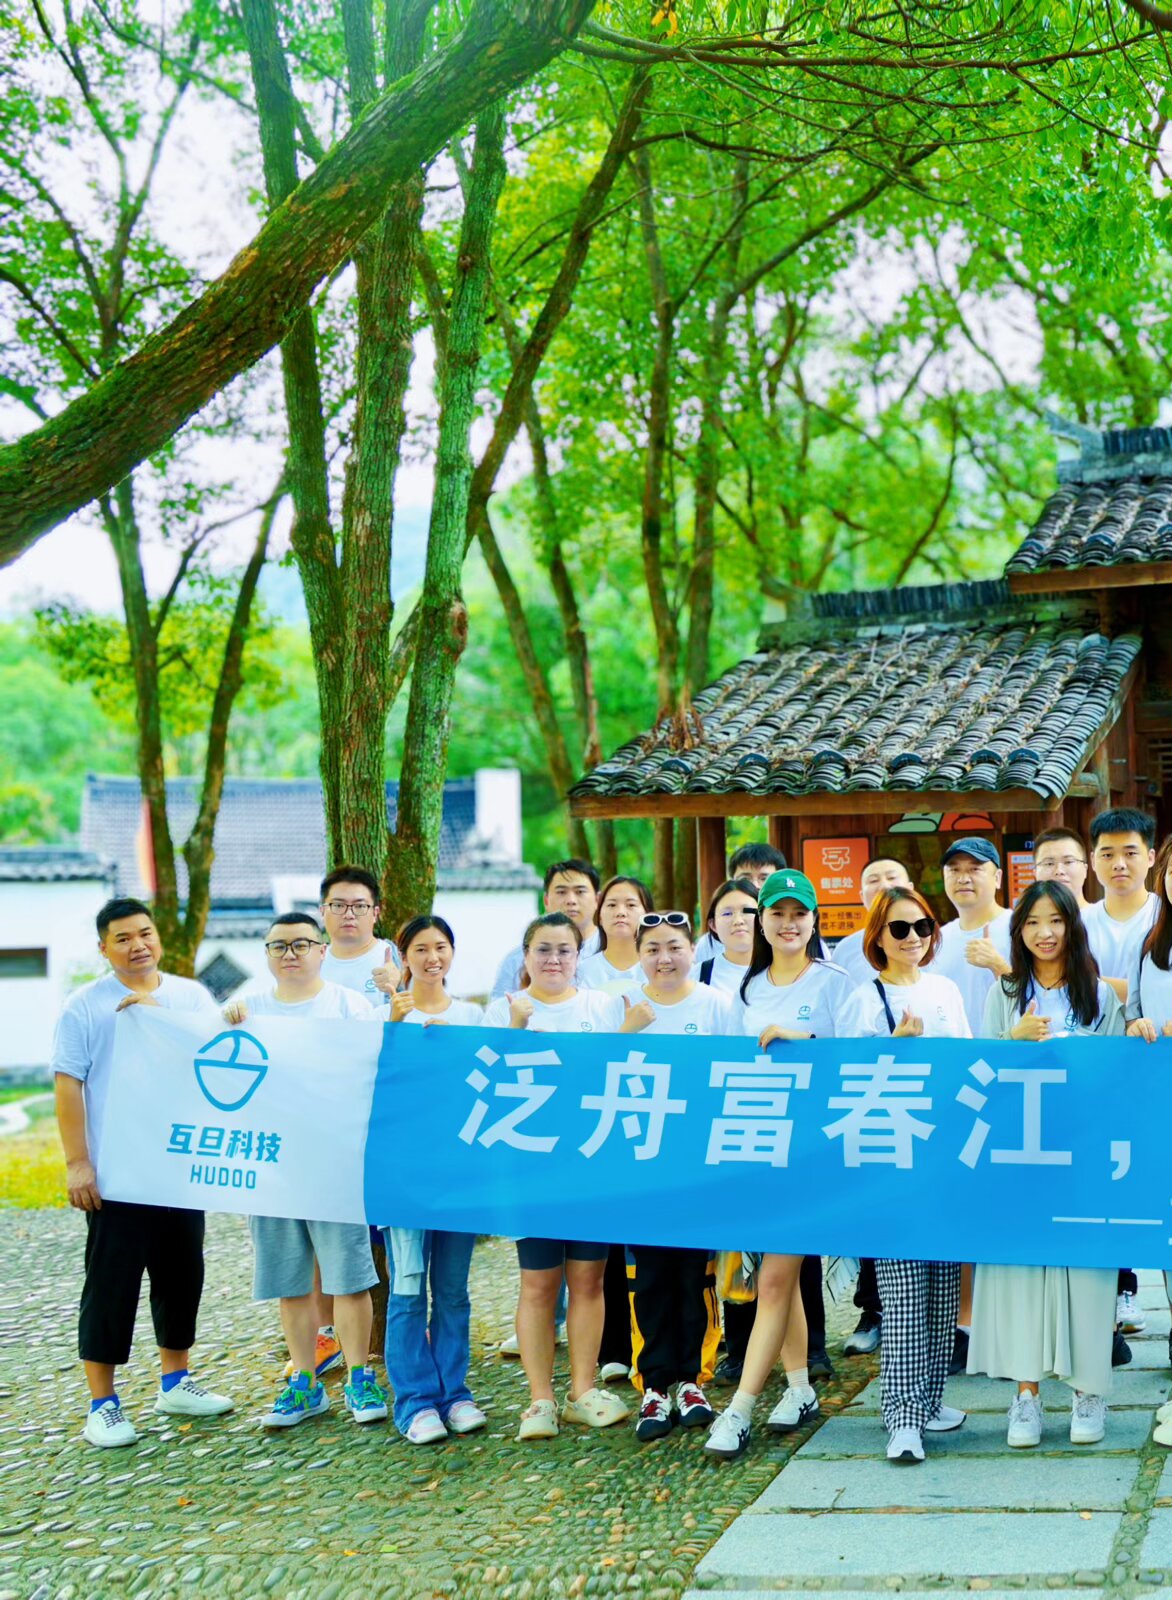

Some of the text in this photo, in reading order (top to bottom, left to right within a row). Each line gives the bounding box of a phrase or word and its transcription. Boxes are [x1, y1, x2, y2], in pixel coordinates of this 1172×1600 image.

[166, 1123, 282, 1163] 互旦科技
[190, 1164, 257, 1190] HUDOO
